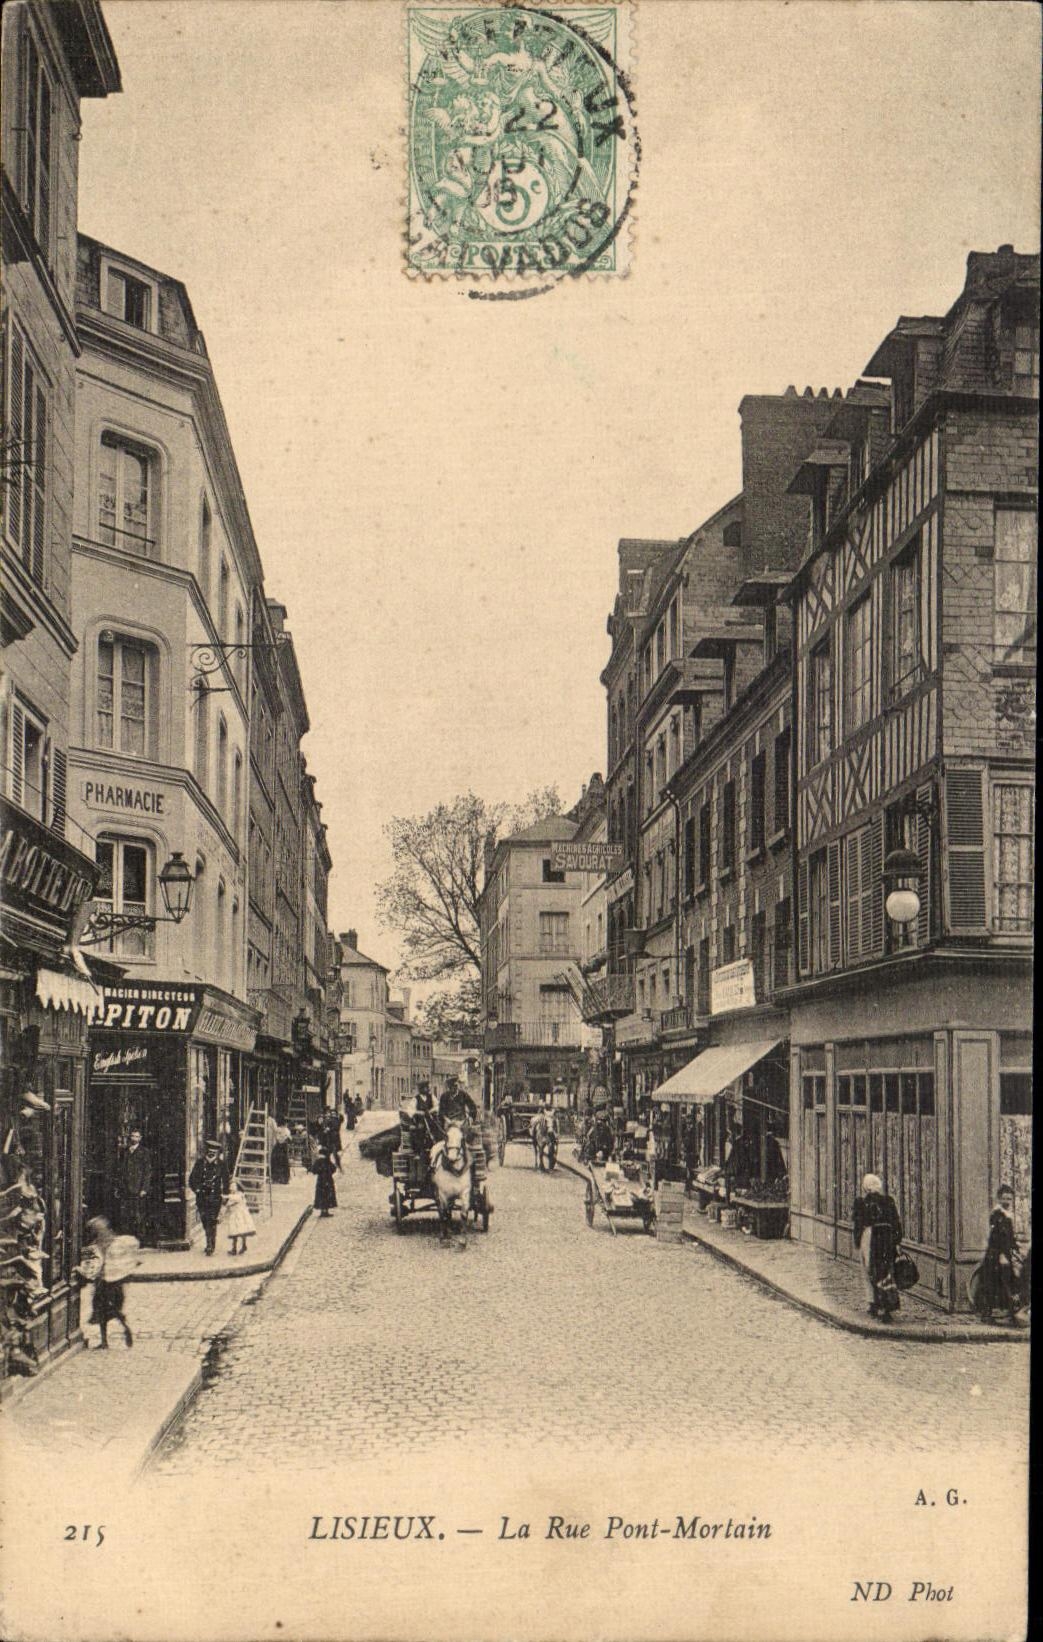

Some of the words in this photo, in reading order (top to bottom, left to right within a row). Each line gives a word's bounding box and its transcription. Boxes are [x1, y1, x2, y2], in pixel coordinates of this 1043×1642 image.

[85, 781, 165, 814] PHARMACIE
[551, 842, 587, 854] MACHINES
[587, 843, 623, 855] AGRICOLES
[555, 852, 613, 870] SAVOURAT
[103, 1003, 192, 1030] PITON
